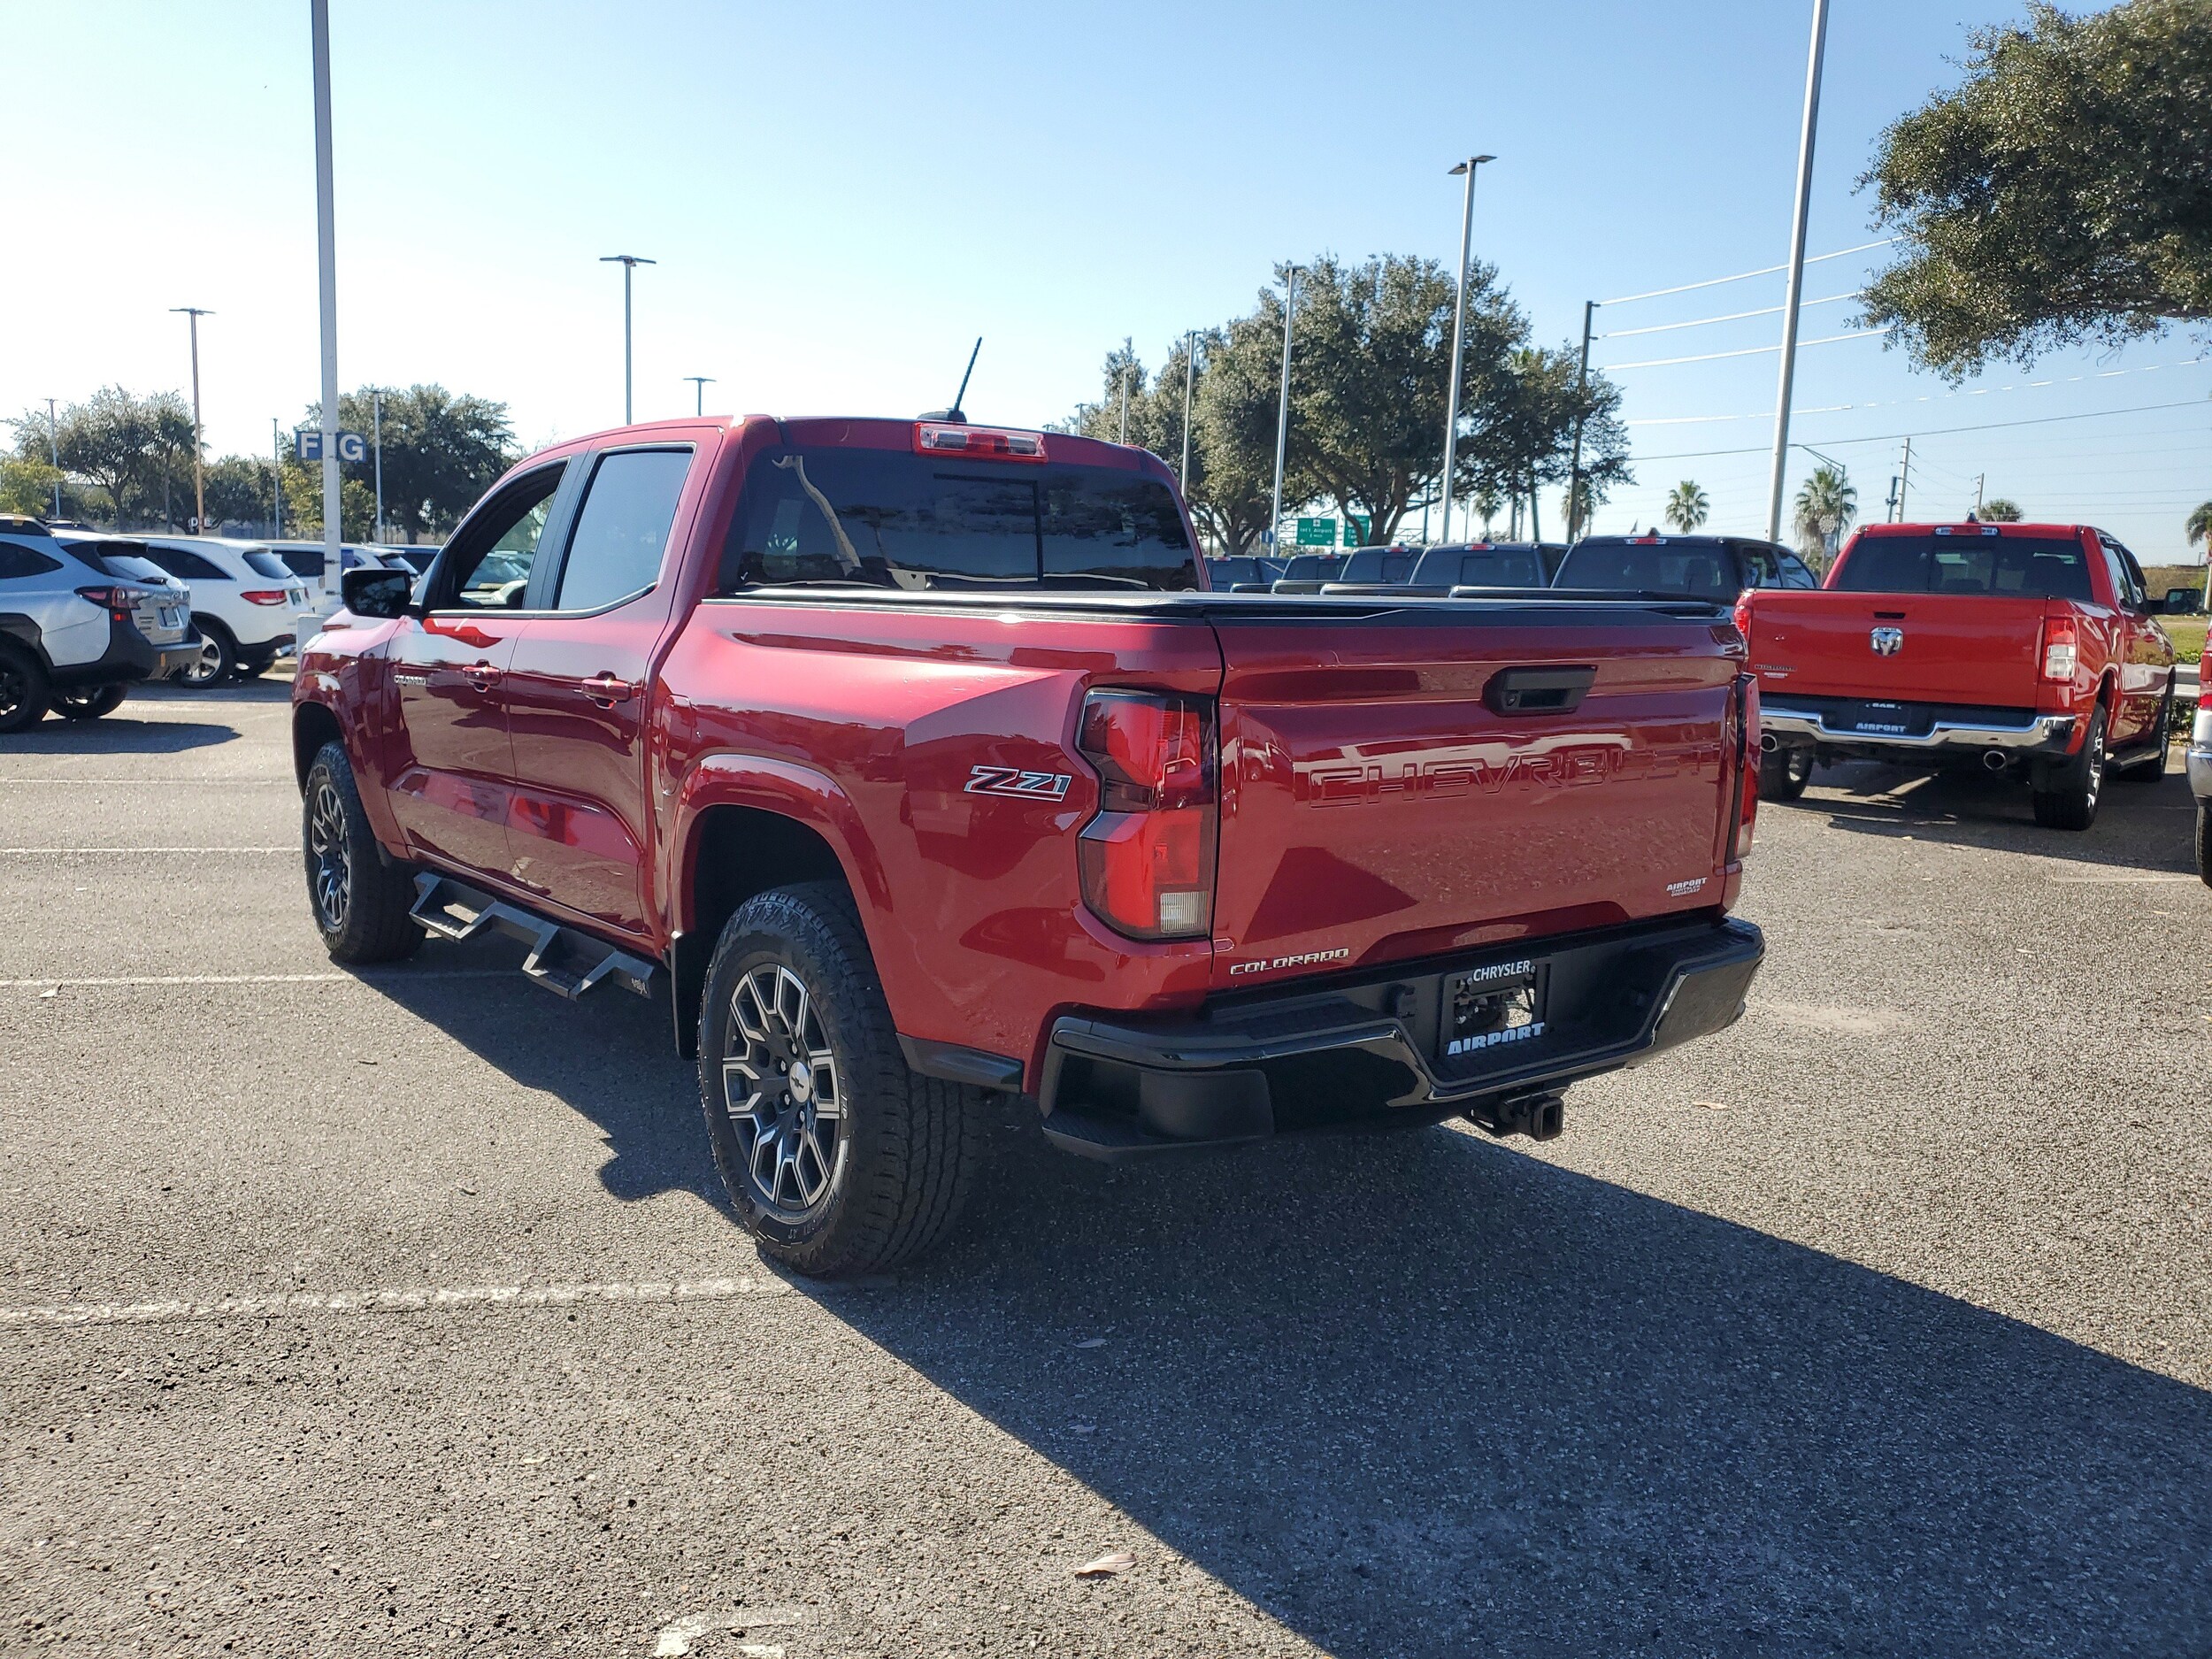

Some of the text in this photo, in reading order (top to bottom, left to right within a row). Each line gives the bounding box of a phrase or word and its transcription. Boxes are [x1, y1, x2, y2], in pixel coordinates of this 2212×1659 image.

[301, 432, 364, 461] F G
[1855, 722, 1906, 733] AIRPORT
[963, 764, 1072, 803] Z71
[1666, 877, 1708, 891] AIRPORT
[1230, 948, 1349, 975] COLORADO
[1472, 960, 1531, 982] CHRYSLER
[1447, 1022, 1545, 1056] AIRPORT
